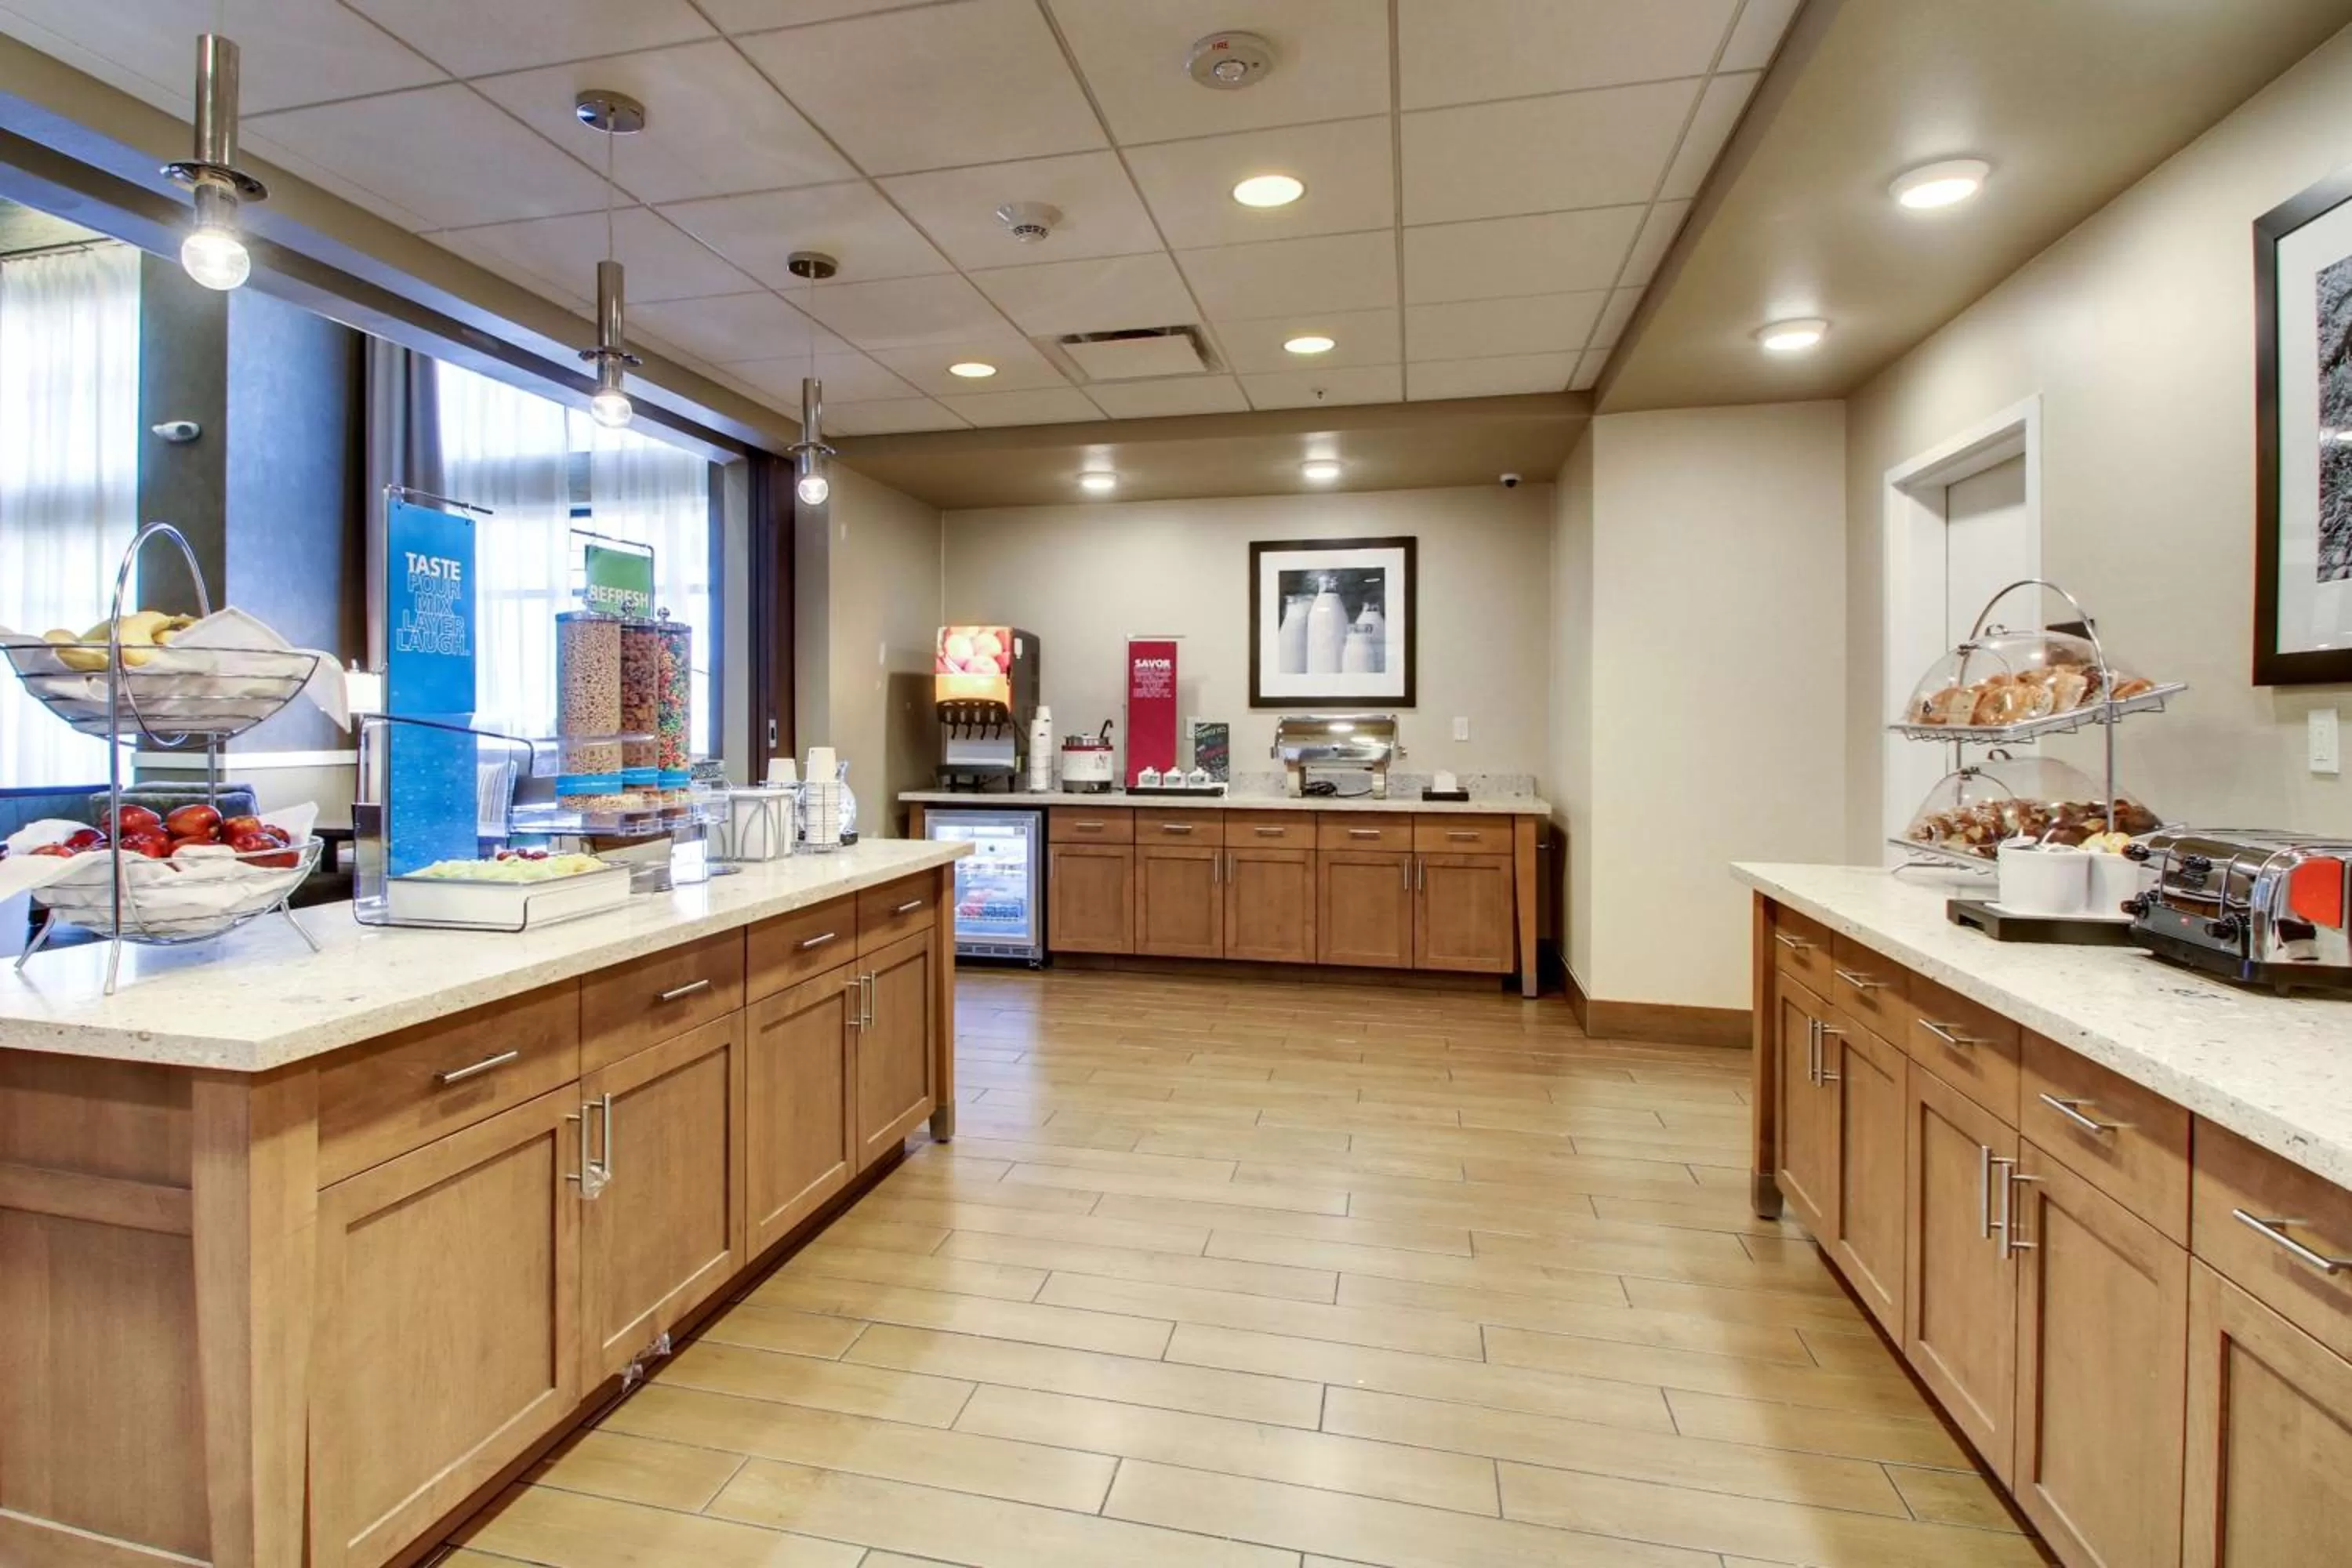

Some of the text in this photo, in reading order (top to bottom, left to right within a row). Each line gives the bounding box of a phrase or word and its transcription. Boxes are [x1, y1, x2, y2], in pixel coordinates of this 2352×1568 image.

[405, 552, 461, 581] TASTE
[407, 572, 462, 600] POUR
[415, 591, 454, 618] MIX
[402, 609, 464, 637] LAYER
[1134, 659, 1171, 669] SAVOR
